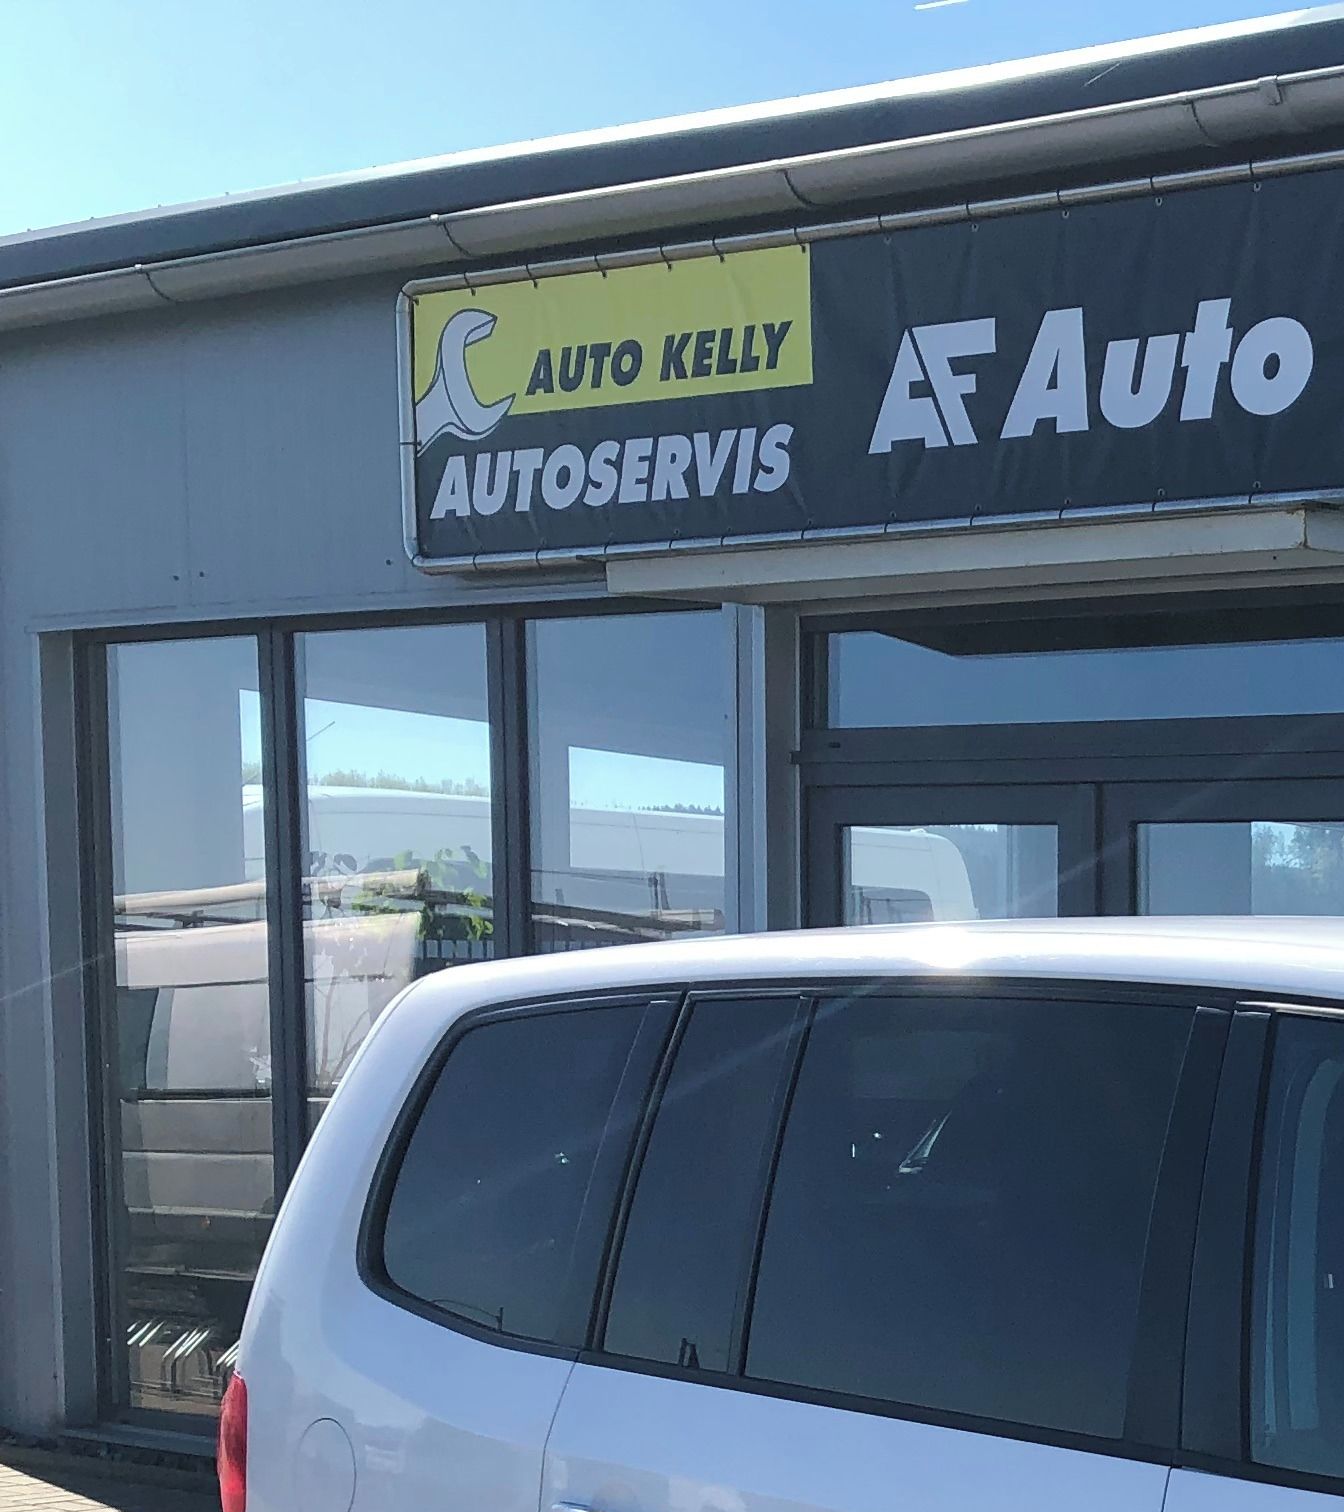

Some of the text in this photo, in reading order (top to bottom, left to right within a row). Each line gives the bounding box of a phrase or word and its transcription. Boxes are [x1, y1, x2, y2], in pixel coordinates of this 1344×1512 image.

[525, 320, 793, 396] AUTO KELLY
[1000, 297, 1314, 439] Auto
[430, 424, 795, 519] AUTOSERVIS
